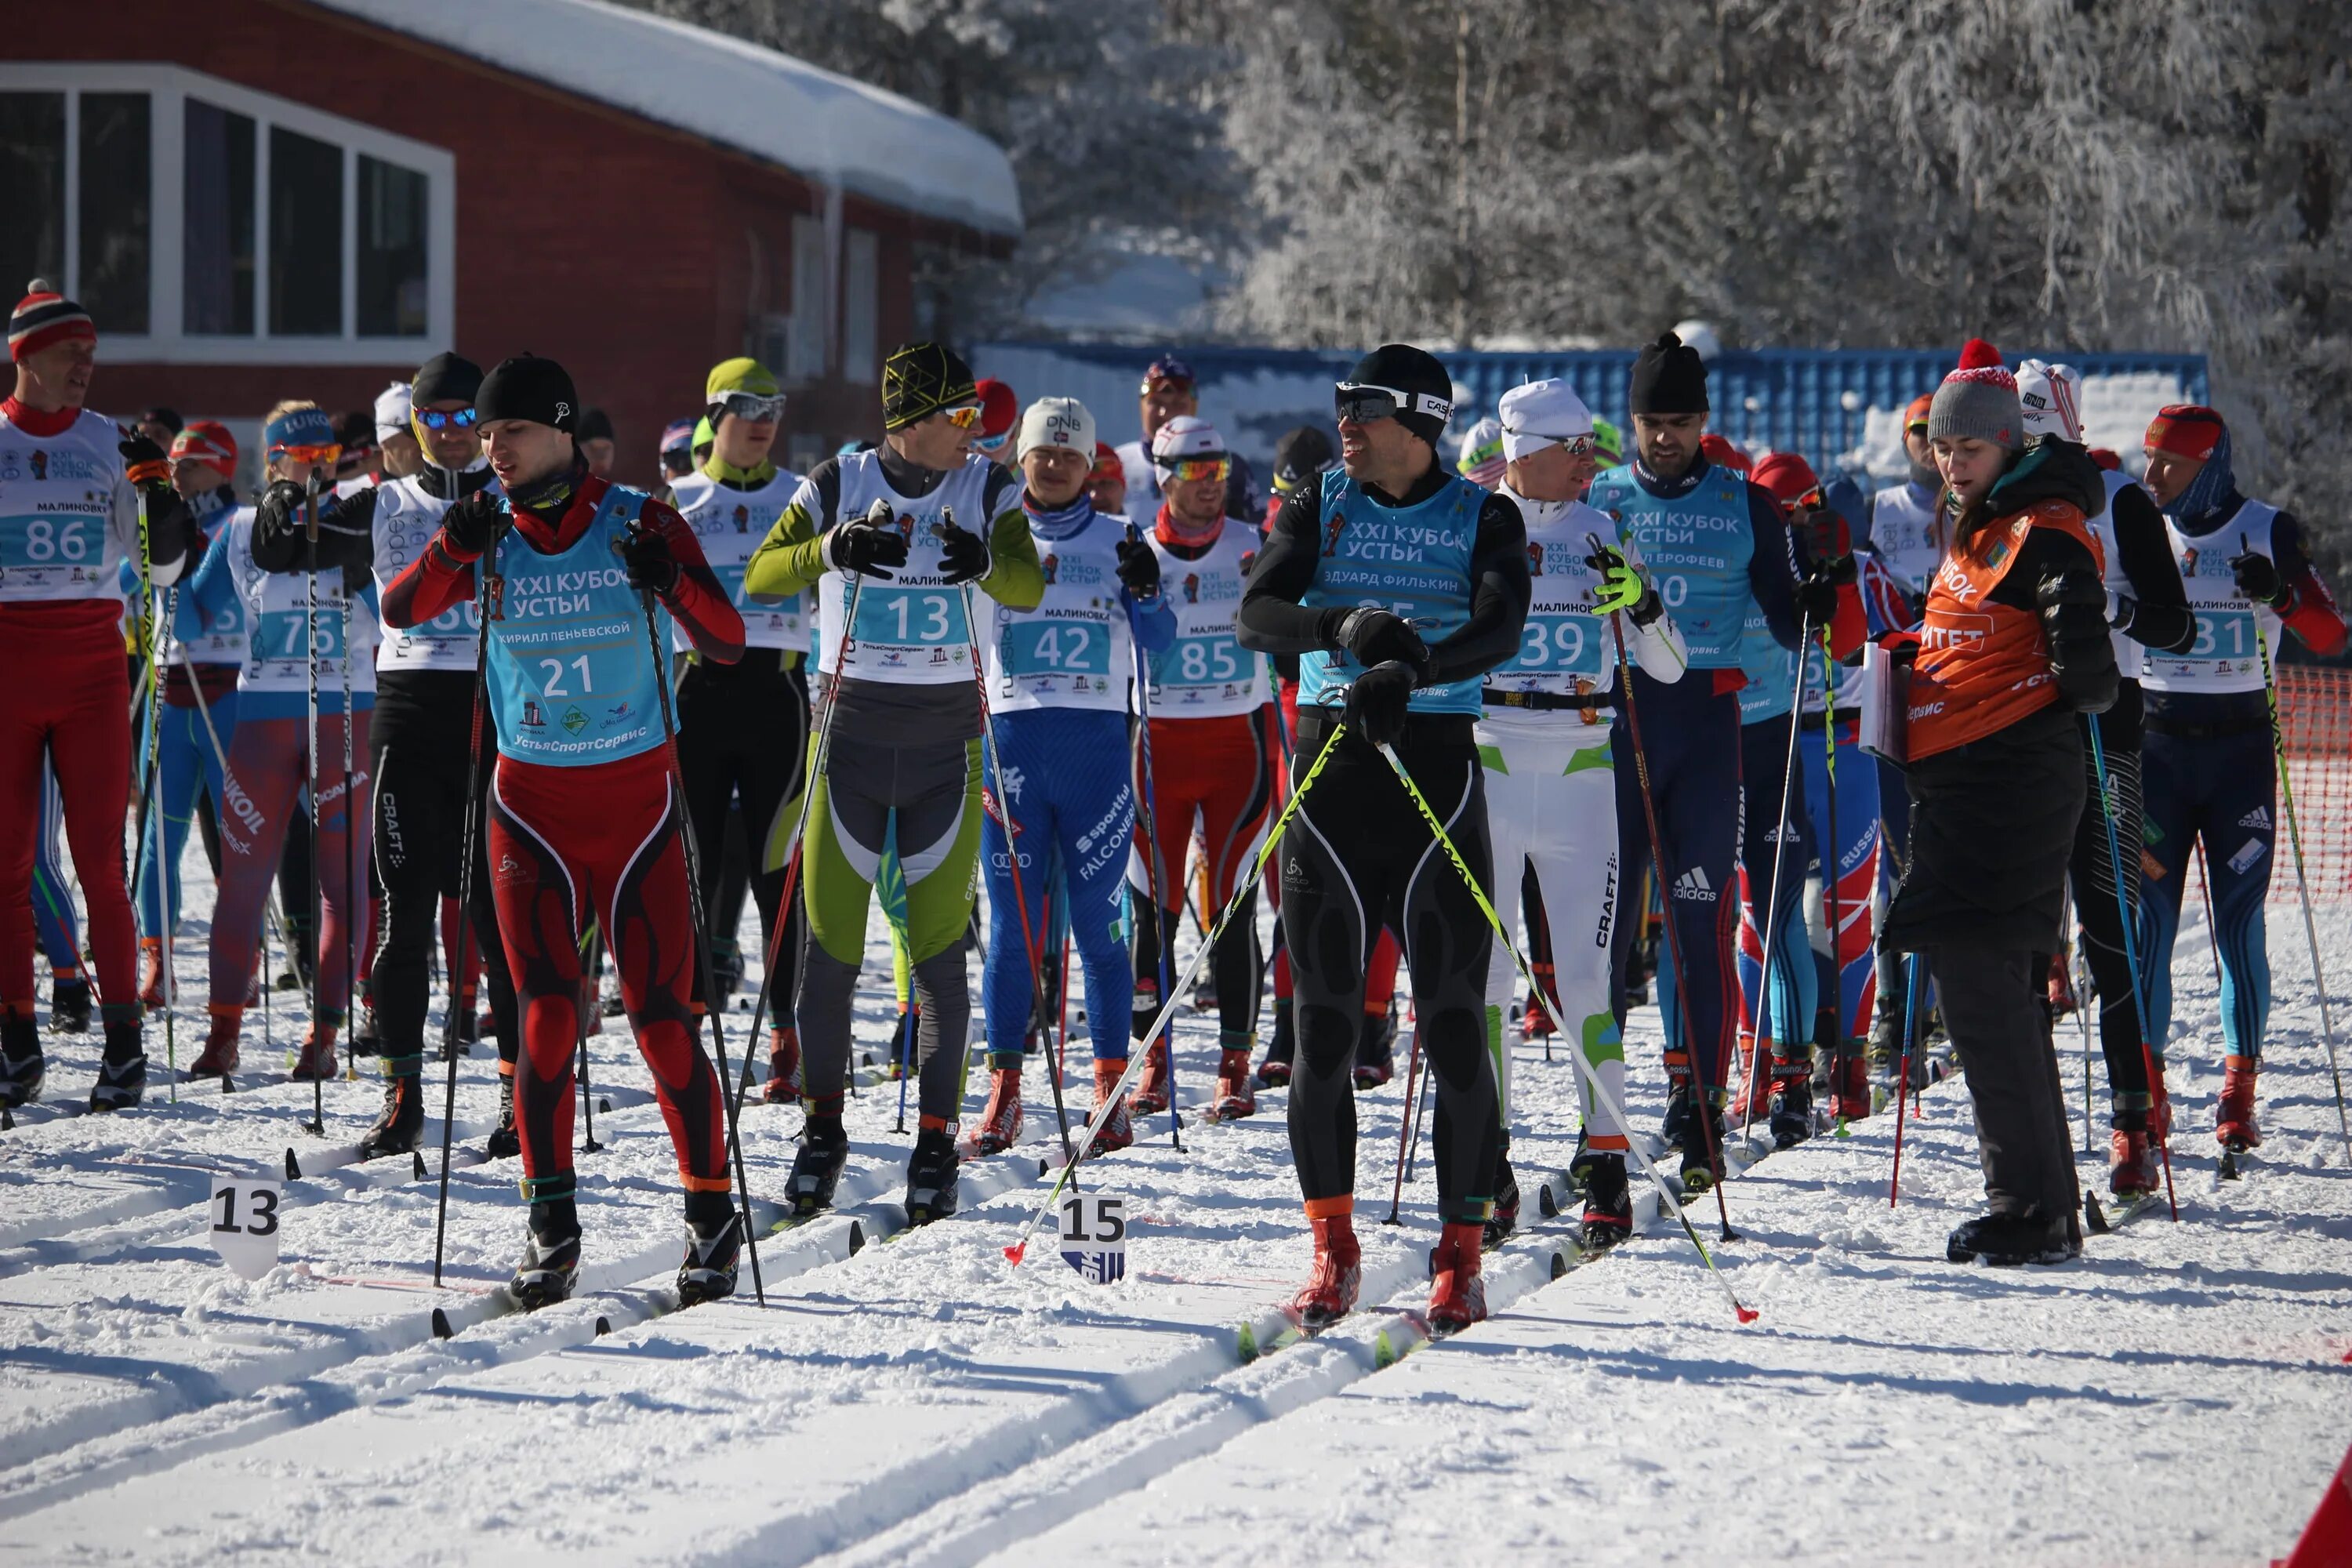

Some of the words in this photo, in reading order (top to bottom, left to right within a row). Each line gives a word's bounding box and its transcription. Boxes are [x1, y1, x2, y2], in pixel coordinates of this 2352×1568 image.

[2024, 394, 2044, 408] DNB
[1047, 415, 1081, 431] DNB
[1627, 511, 1661, 528] XXI
[1667, 512, 1740, 534] КУБОК
[26, 520, 87, 561] 86
[1348, 521, 1388, 540] XXI
[1394, 524, 1469, 552] КУБОК
[1546, 542, 1568, 554] XXI
[1061, 554, 1082, 564] XXI
[1345, 541, 1424, 563] УСТЬИ
[1656, 552, 1725, 569] ЕРОФЕЕВ
[1061, 564, 1102, 577] КУБОК
[1061, 574, 1102, 585] УСТЬИ
[1324, 570, 1381, 586] ЭДУАРД
[1383, 570, 1459, 593] ФИЛЬКИН
[1547, 564, 1588, 578] УСТЬИ
[512, 577, 551, 597] XXI
[1202, 580, 1240, 591] КУБОК
[1202, 591, 1240, 602] УСТЬИ
[514, 593, 590, 619] УСТЬИ
[1044, 608, 1111, 622] МАЛИНОВКА
[887, 596, 949, 641] 13
[283, 615, 335, 655] 76
[499, 632, 548, 644] КИРИЛЛ
[551, 621, 630, 642] ПЕНЬЕВСКОЙ
[1033, 626, 1091, 669] 42
[1519, 622, 1585, 667] 39
[1181, 641, 1236, 681] 85
[539, 654, 593, 698] 21
[514, 725, 648, 753] УстьяСпортСервис
[383, 792, 405, 853] CRAFT
[2238, 818, 2272, 831] adidas
[1842, 818, 1879, 869] RUSSIA
[1673, 886, 1717, 902] adidas
[1595, 871, 1618, 949] CRAFT
[213, 1186, 279, 1236] 13
[1063, 1198, 1125, 1243] 15
